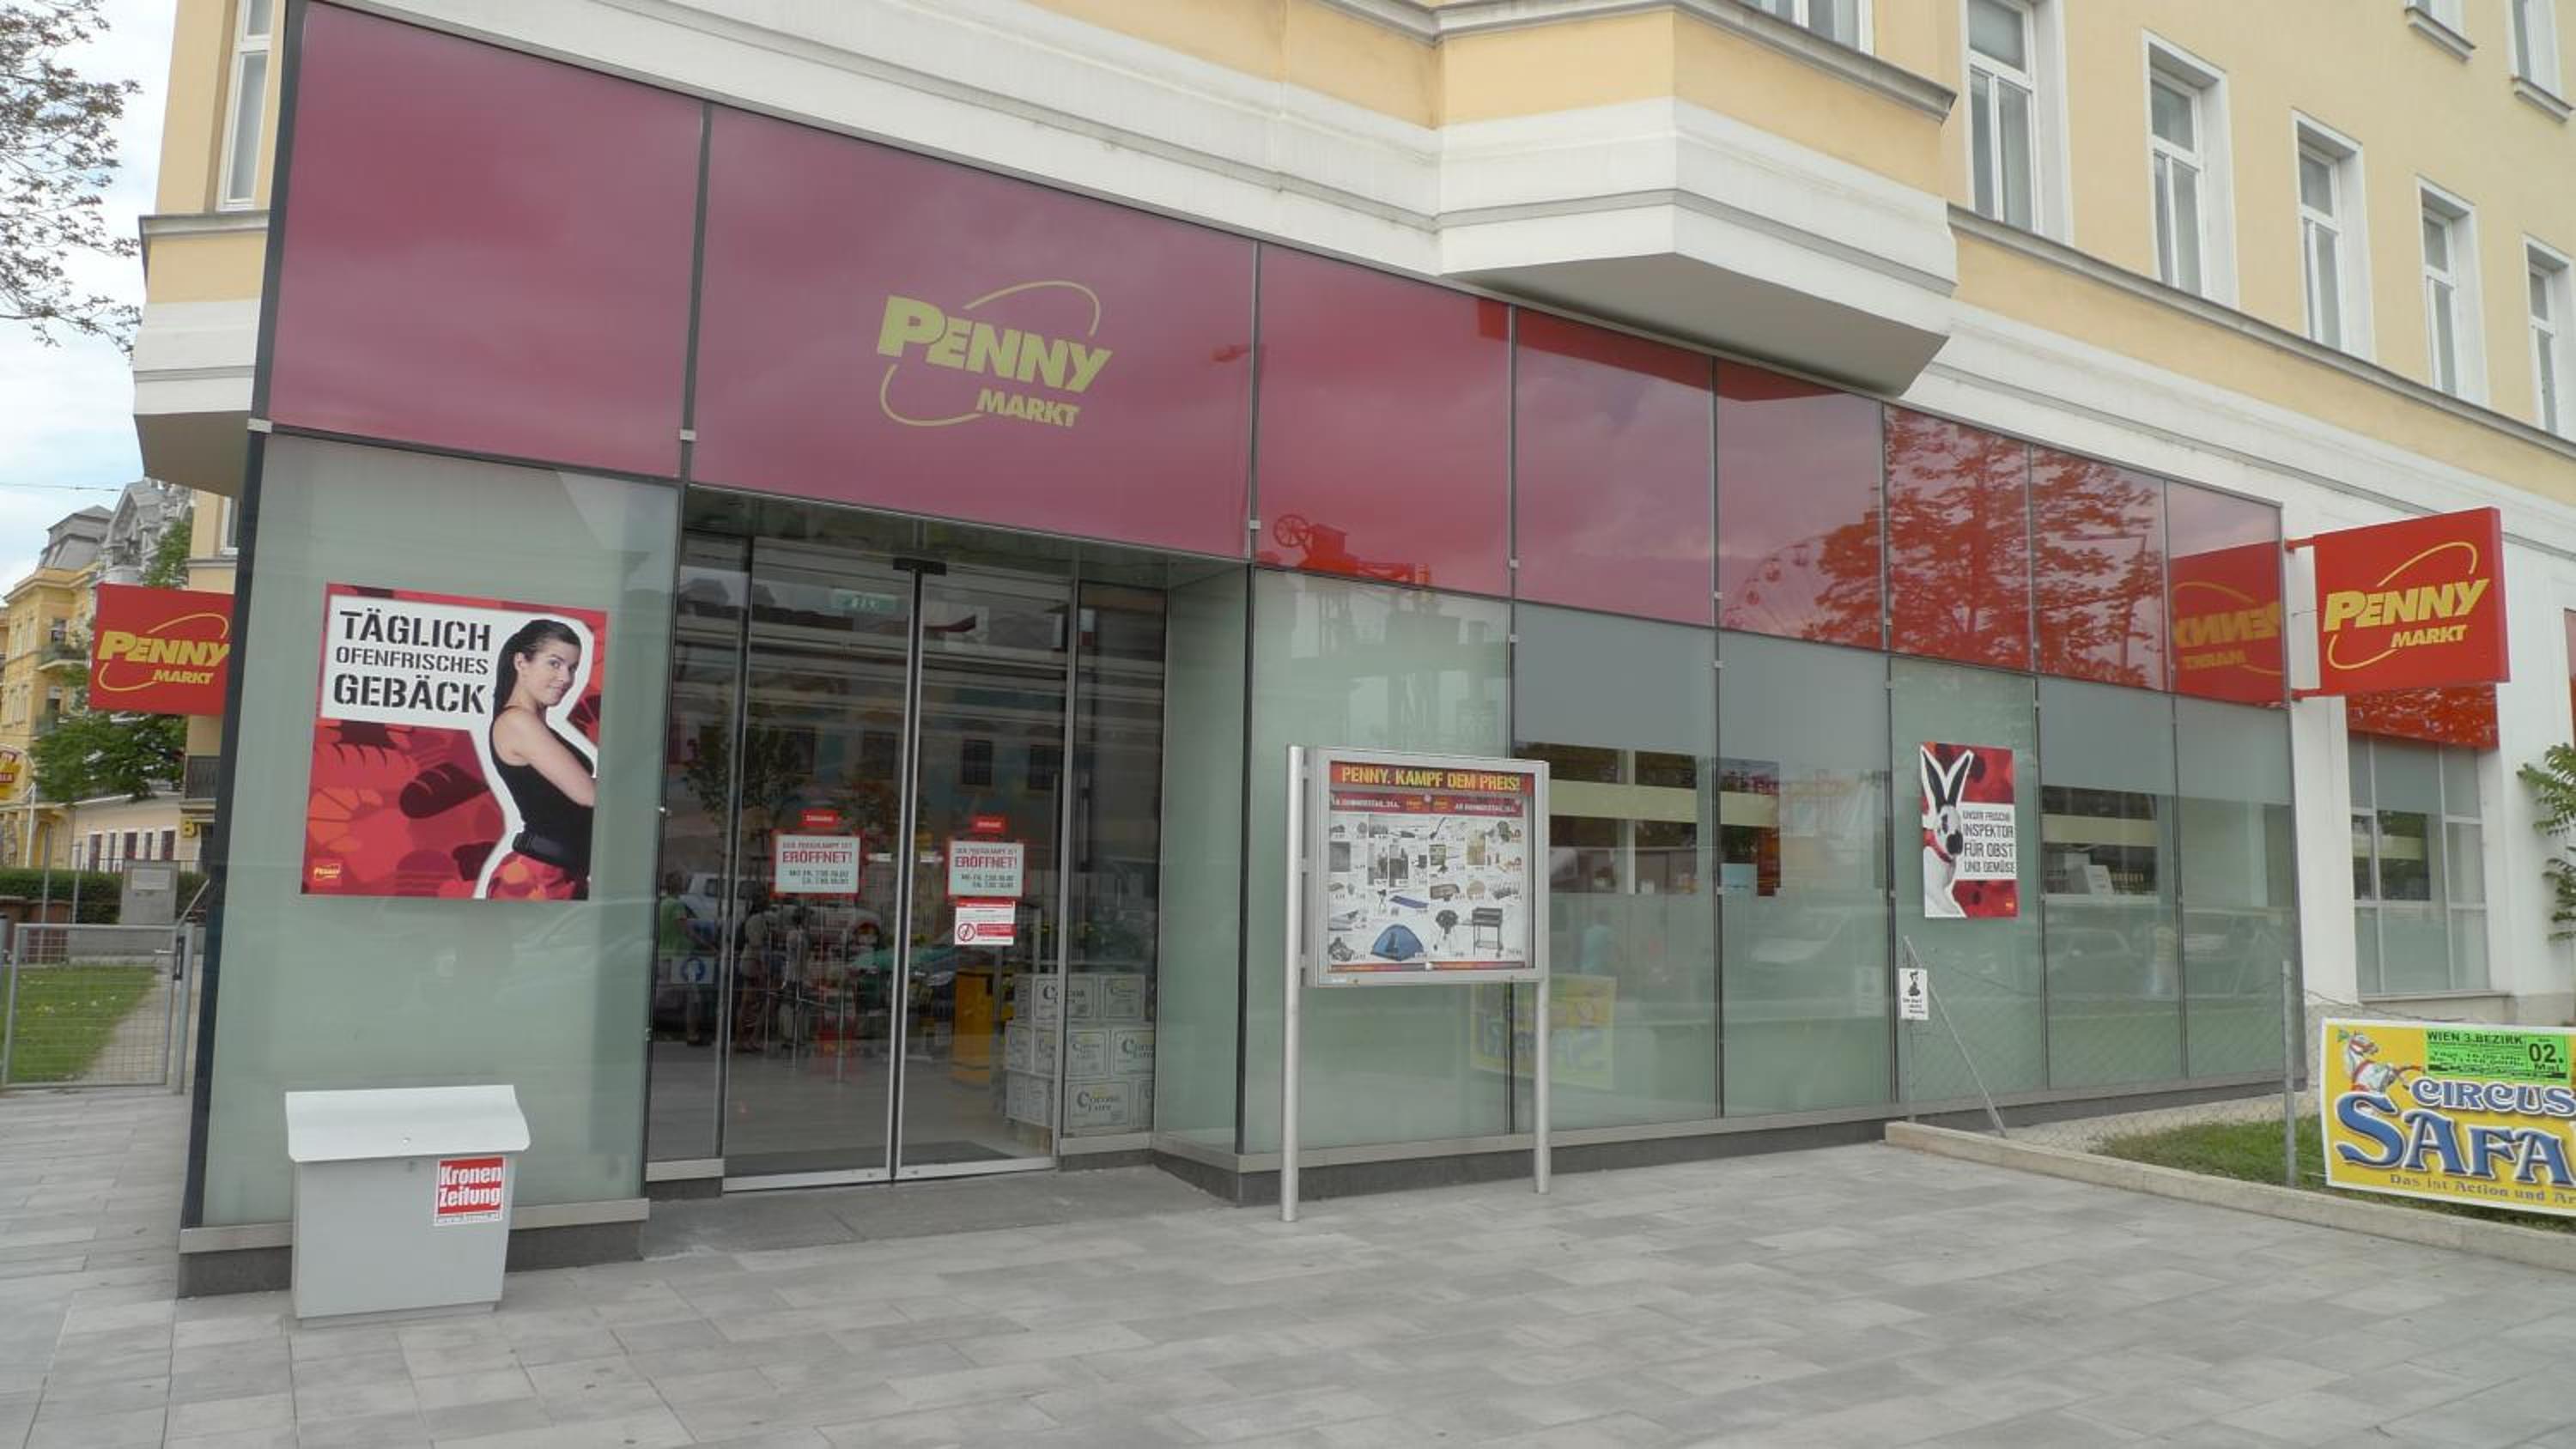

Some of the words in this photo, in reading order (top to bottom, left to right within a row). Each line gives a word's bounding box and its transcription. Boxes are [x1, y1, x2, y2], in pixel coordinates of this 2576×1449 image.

[877, 294, 1113, 393] PENNY
[975, 387, 1080, 427] MARKT
[2324, 578, 2490, 633] PENNY
[339, 607, 491, 652] TÄGLICH
[2391, 624, 2468, 648] MARKT
[96, 630, 231, 667] PENNY
[335, 646, 489, 676] OFENFRISCHES
[152, 669, 214, 684] MARKT
[333, 673, 487, 715] GEBÄCK
[1341, 767, 1390, 785] PENNY.
[1395, 770, 1443, 787] KAMPF
[1447, 773, 1476, 789] DEM
[1479, 775, 1521, 791] PREIS!
[1964, 824, 2014, 838] INSPEKTOR
[1964, 840, 1984, 857] FÜR
[1986, 842, 2014, 858] OBST
[1965, 861, 1981, 872] UND
[1984, 861, 2015, 873] GEMÜSE
[2427, 1031, 2459, 1042] WIEN
[2529, 1043, 2564, 1064] 02.
[2410, 1078, 2576, 1116] CIRCUS
[440, 1166, 501, 1185] Kronen
[2391, 1173, 2419, 1186] Das
[2427, 1177, 2446, 1189] ist
[2454, 1180, 2508, 1197] Action
[2515, 1188, 2545, 1201] und
[440, 1185, 501, 1207] Zeitung
